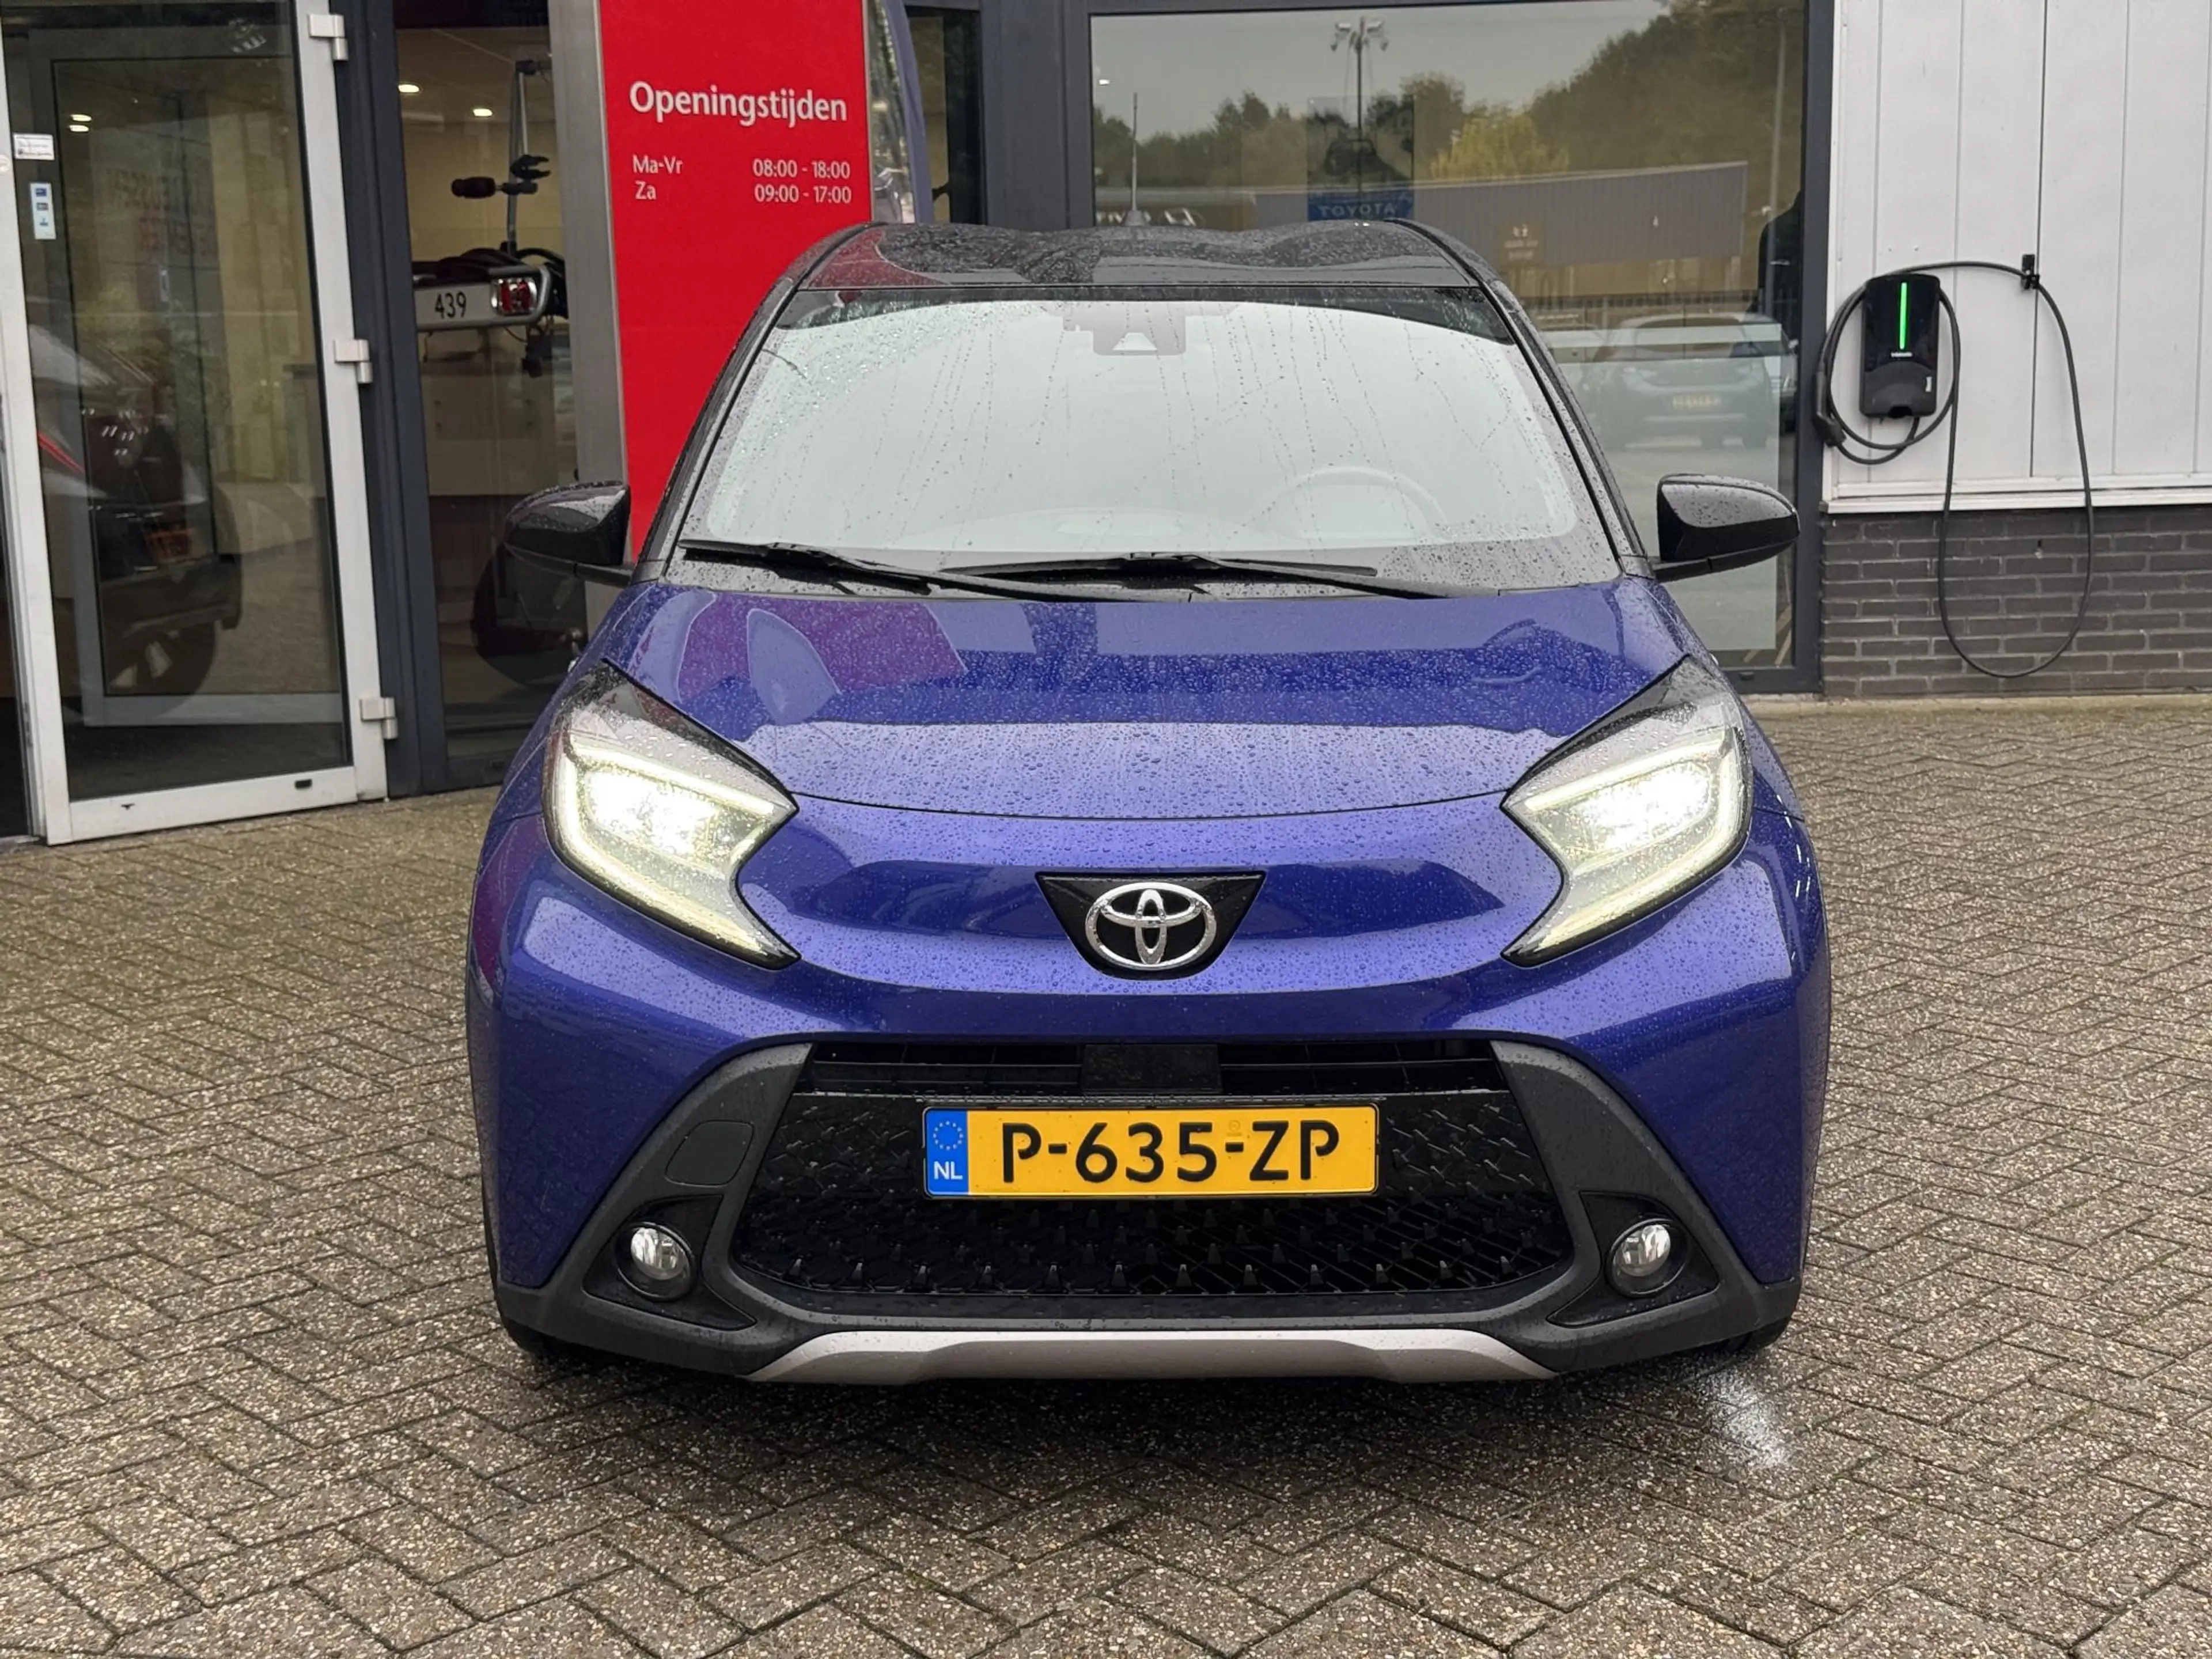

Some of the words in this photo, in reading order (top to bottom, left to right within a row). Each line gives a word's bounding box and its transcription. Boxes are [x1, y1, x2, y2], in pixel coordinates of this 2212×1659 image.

[629, 81, 847, 128] Openingstijden
[632, 154, 683, 174] Ma-Vr
[752, 158, 798, 178] 08:00
[812, 160, 851, 179] 18:00
[635, 180, 657, 200] Za
[754, 183, 800, 203] 09:00
[813, 185, 852, 204] 17:00
[1317, 202, 1396, 217] TOYOTA
[434, 291, 467, 319] 439
[1002, 1120, 1339, 1183] P-635-ZP
[933, 1161, 963, 1180] NL
